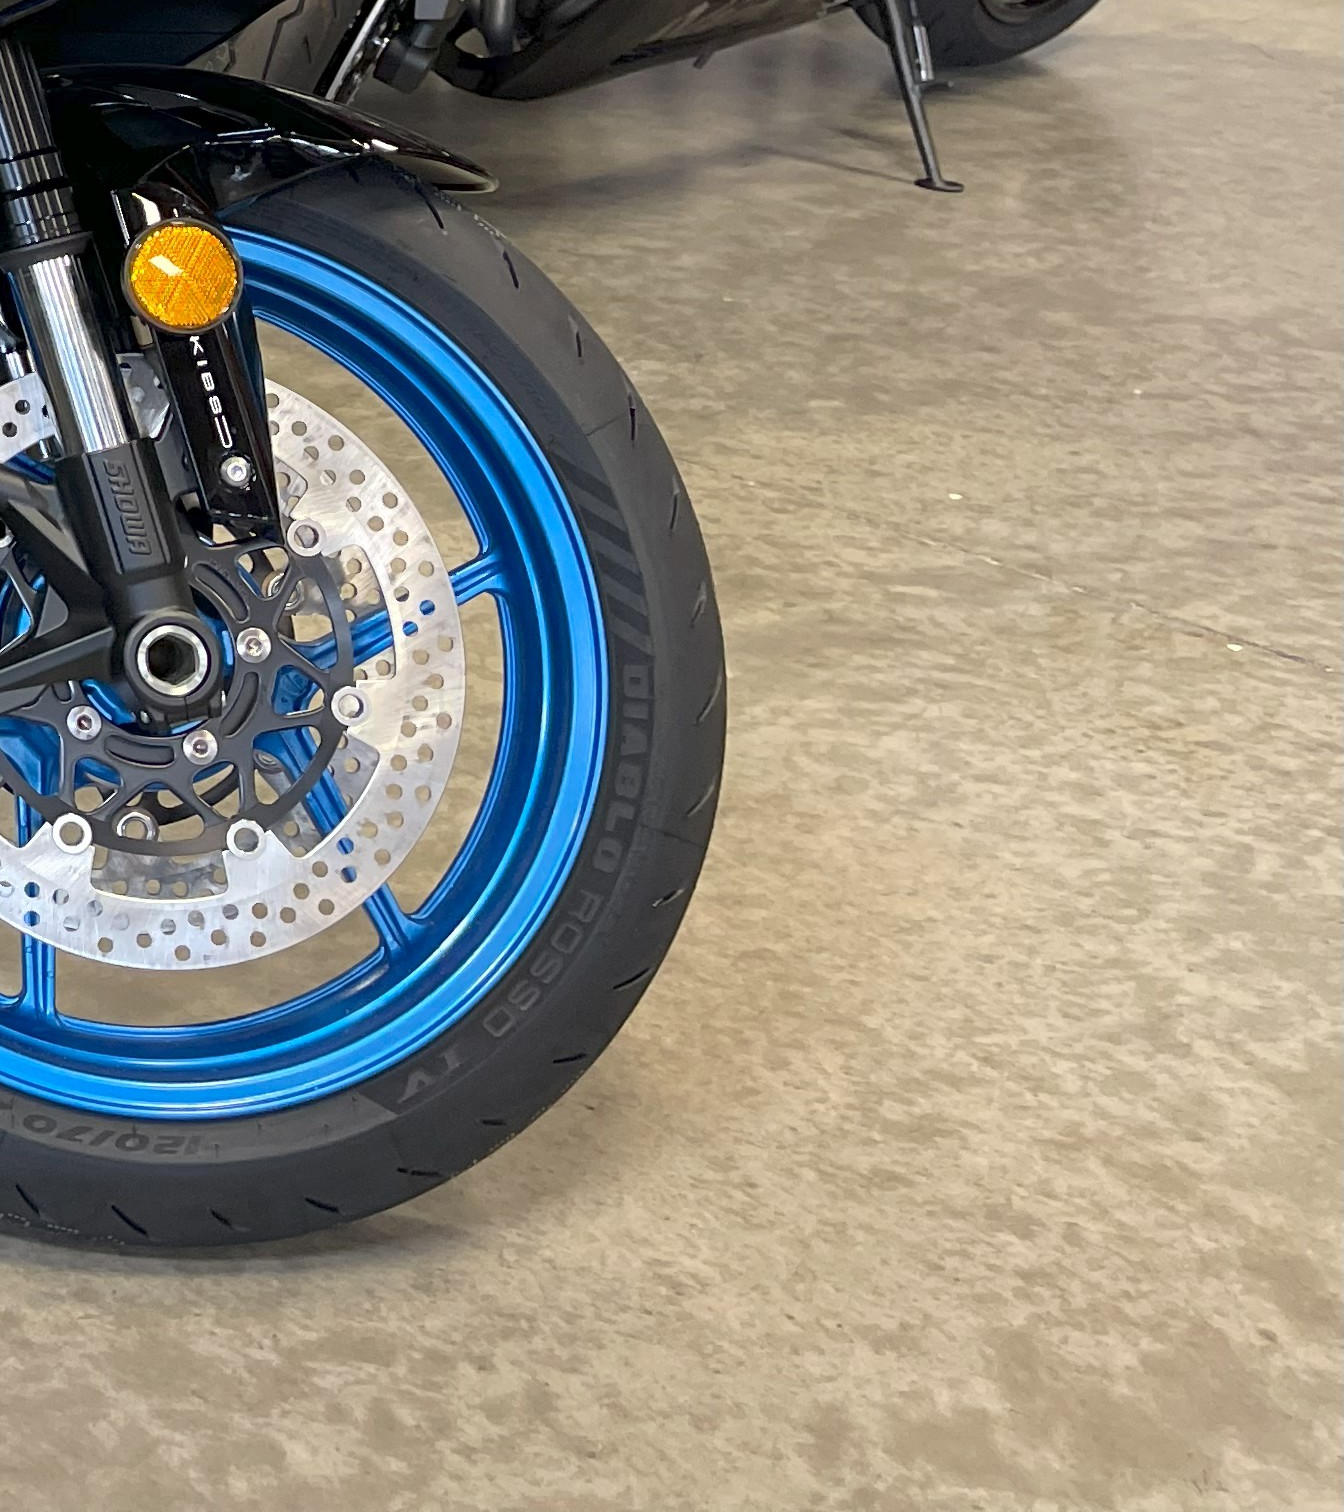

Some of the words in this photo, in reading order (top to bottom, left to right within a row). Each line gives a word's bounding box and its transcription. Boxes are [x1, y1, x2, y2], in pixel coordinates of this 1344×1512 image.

[102, 458, 153, 557] SHOWA
[592, 663, 650, 874] DIABLO
[482, 888, 605, 1039] ROSSO
[396, 1042, 469, 1105] IV
[21, 1113, 202, 1156] 120/70
